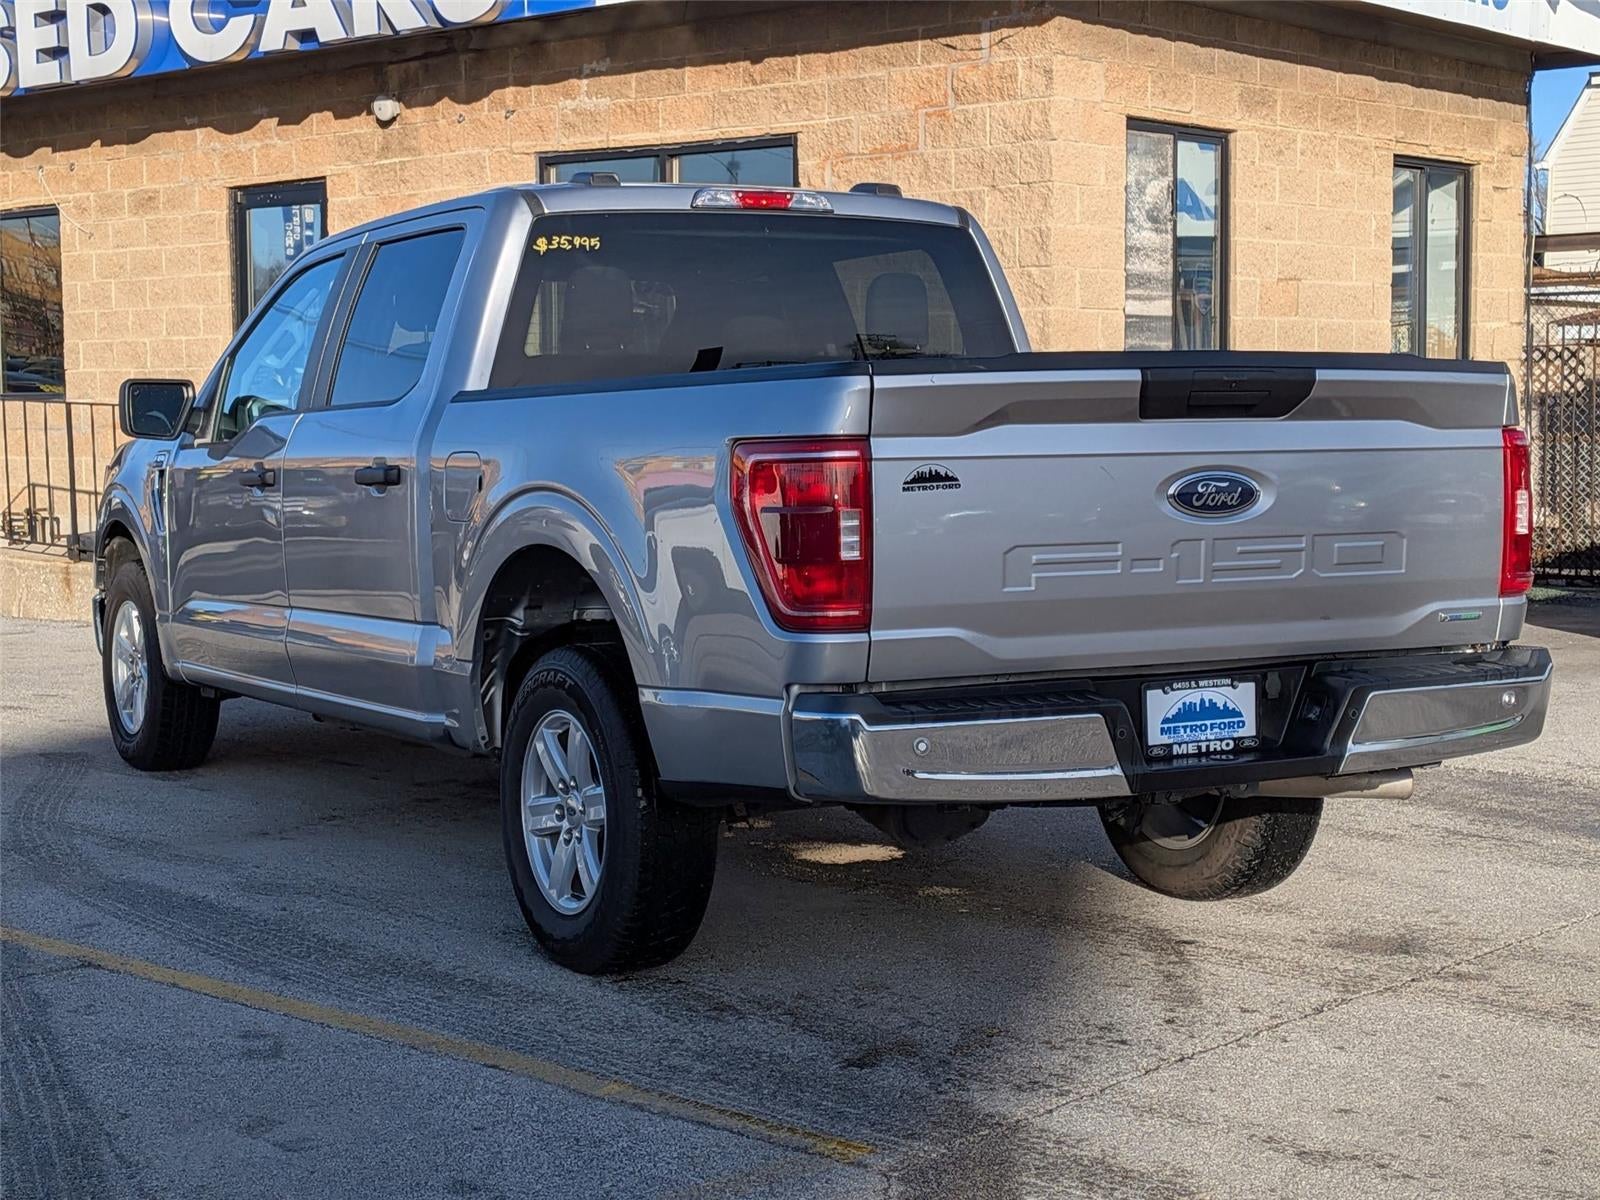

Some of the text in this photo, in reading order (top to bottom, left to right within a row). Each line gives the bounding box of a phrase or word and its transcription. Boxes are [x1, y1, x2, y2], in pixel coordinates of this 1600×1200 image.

[532, 236, 600, 255] $35,995
[1192, 480, 1241, 506] Ford
[1002, 531, 1407, 592] F-150
[1198, 678, 1232, 687] WESTERN
[1172, 739, 1235, 755] METRO
